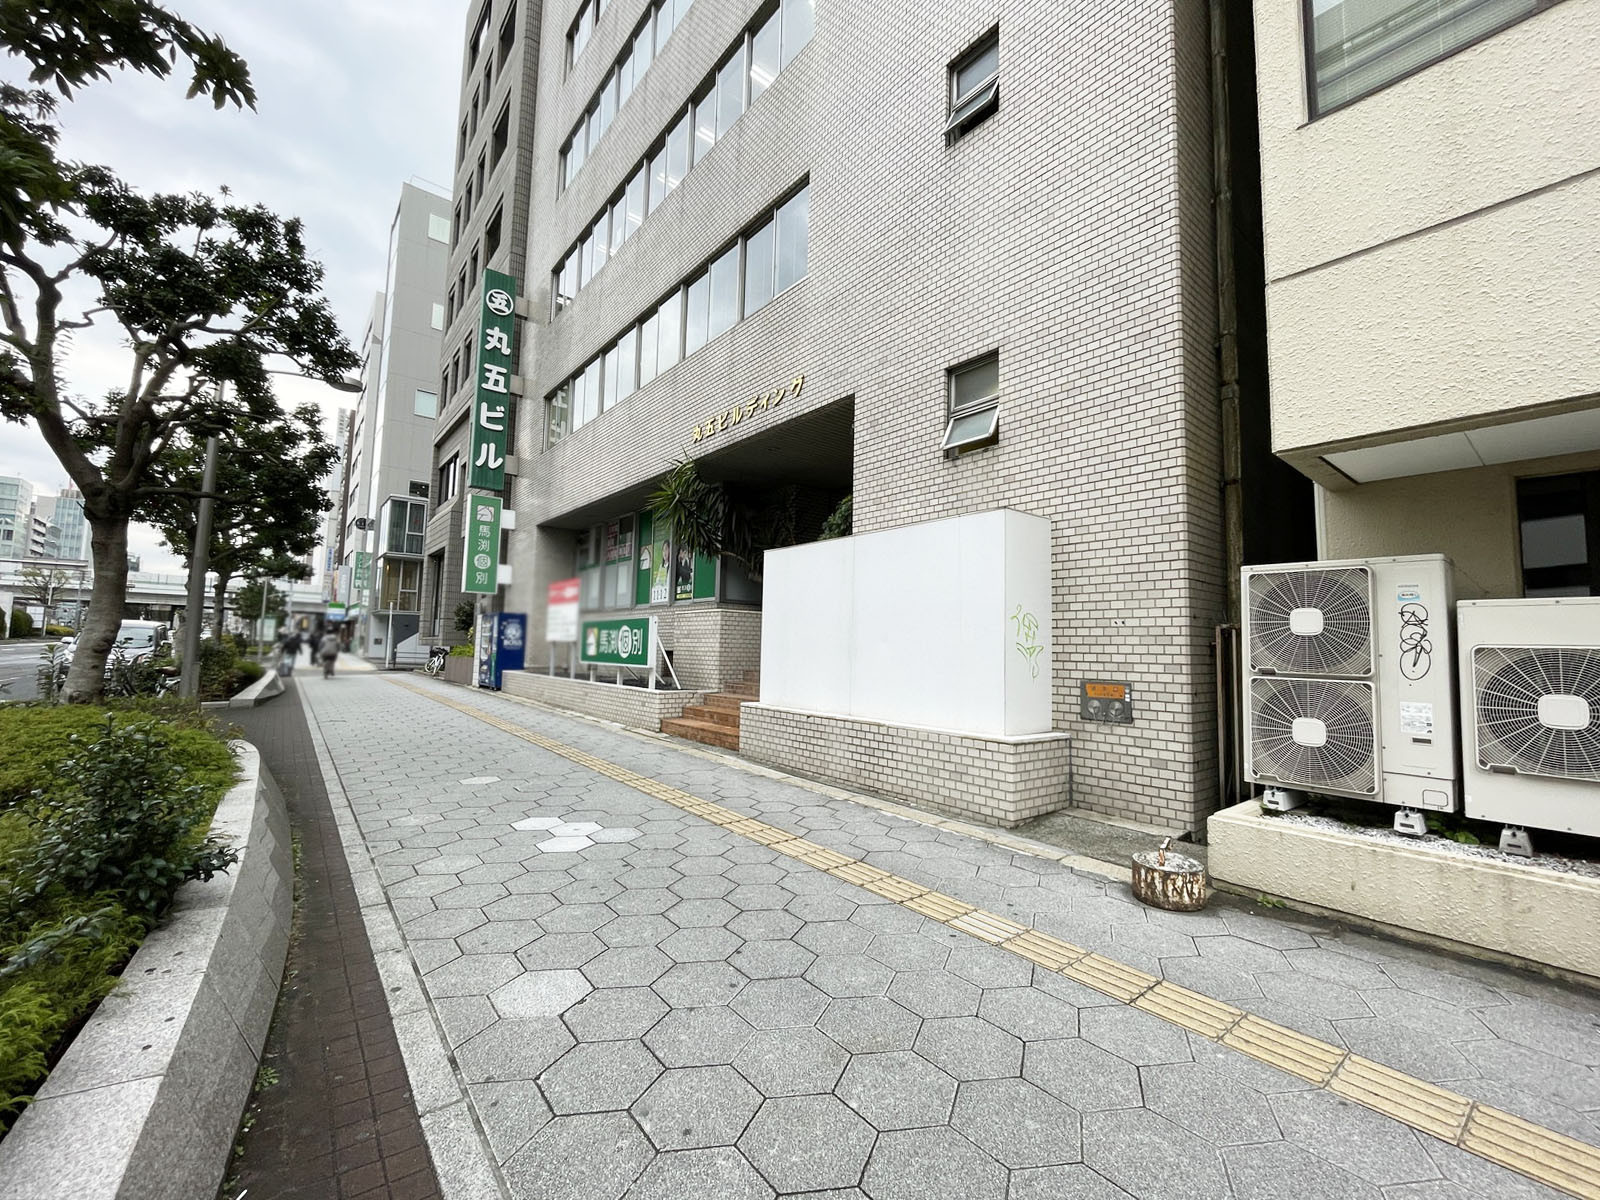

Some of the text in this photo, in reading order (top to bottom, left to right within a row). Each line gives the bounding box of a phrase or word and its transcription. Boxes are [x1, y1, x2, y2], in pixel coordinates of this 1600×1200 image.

[475, 325, 511, 470] 丸五ビル
[692, 374, 806, 443] 丸五ビルディング
